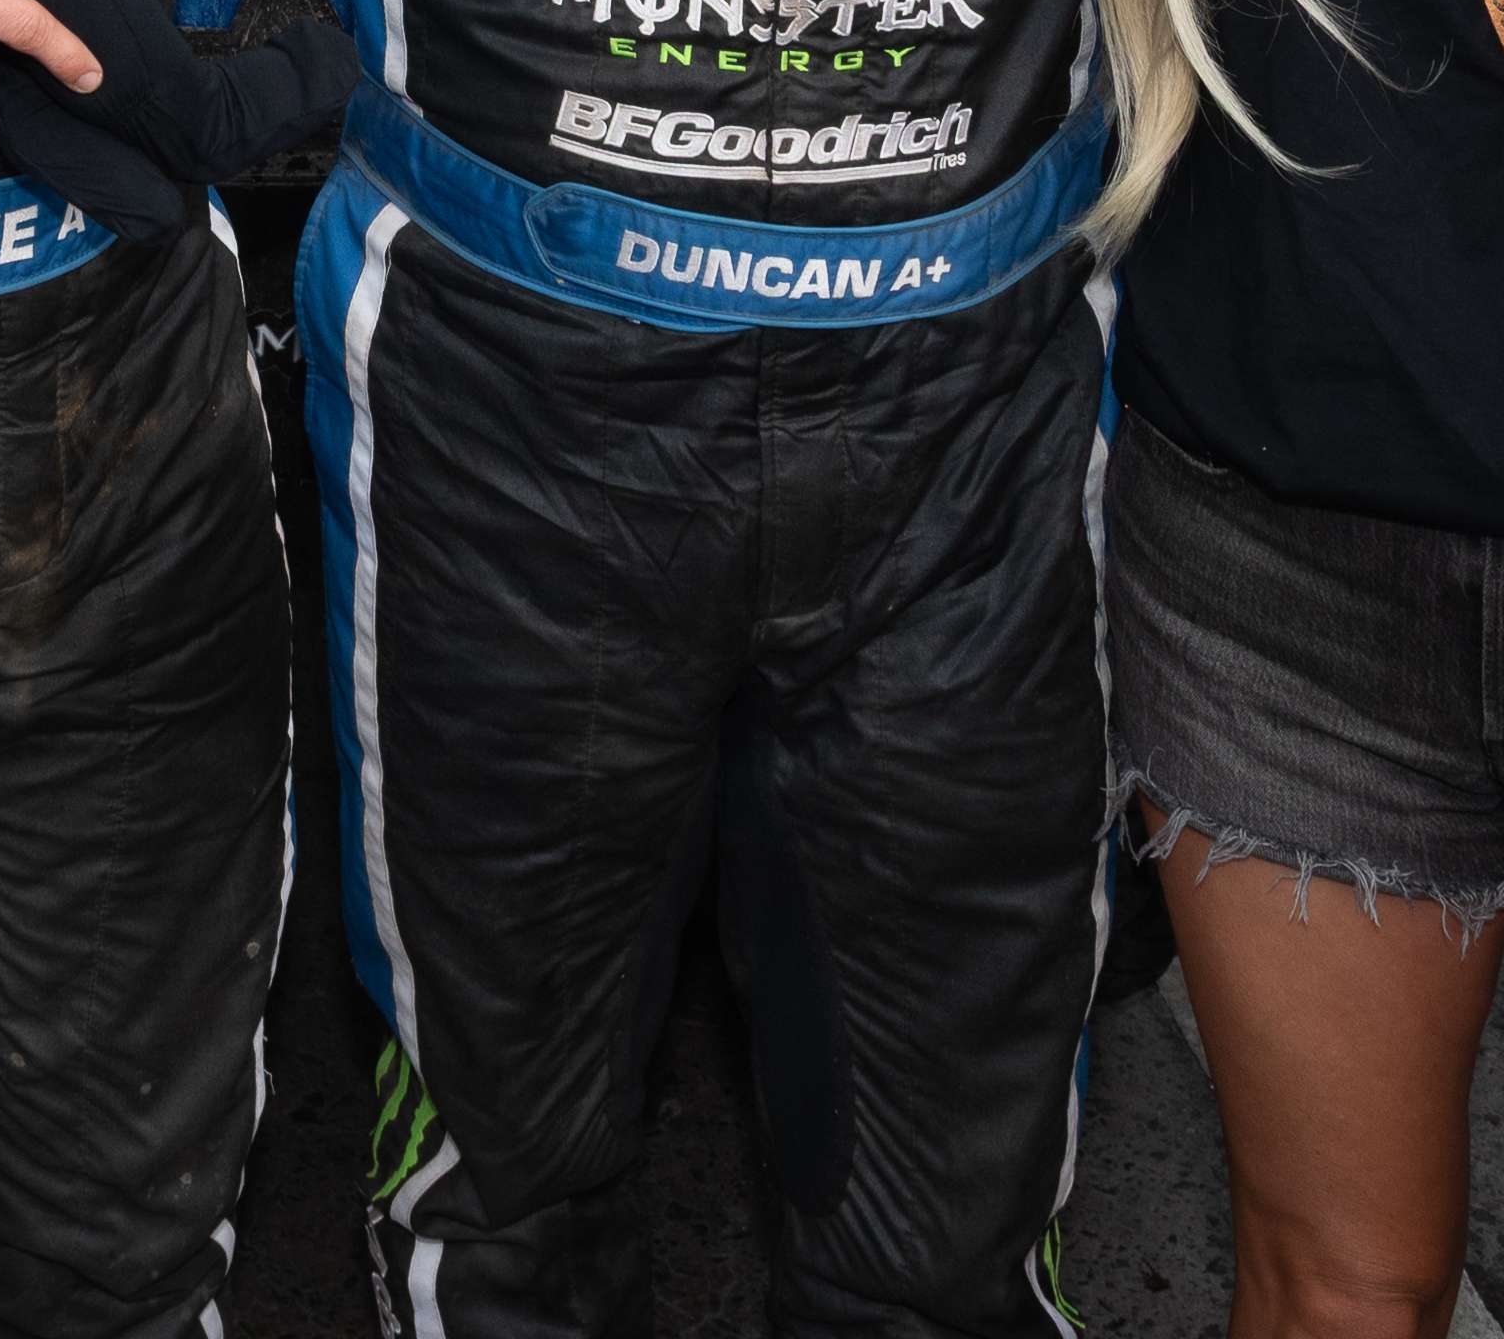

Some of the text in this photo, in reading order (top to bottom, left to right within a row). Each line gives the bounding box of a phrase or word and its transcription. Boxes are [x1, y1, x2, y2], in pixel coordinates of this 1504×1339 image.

[609, 36, 916, 74] ENERGY
[554, 88, 973, 166] BFGoodrich
[931, 149, 968, 172] Tires
[616, 227, 952, 301] DUNCAN A+
